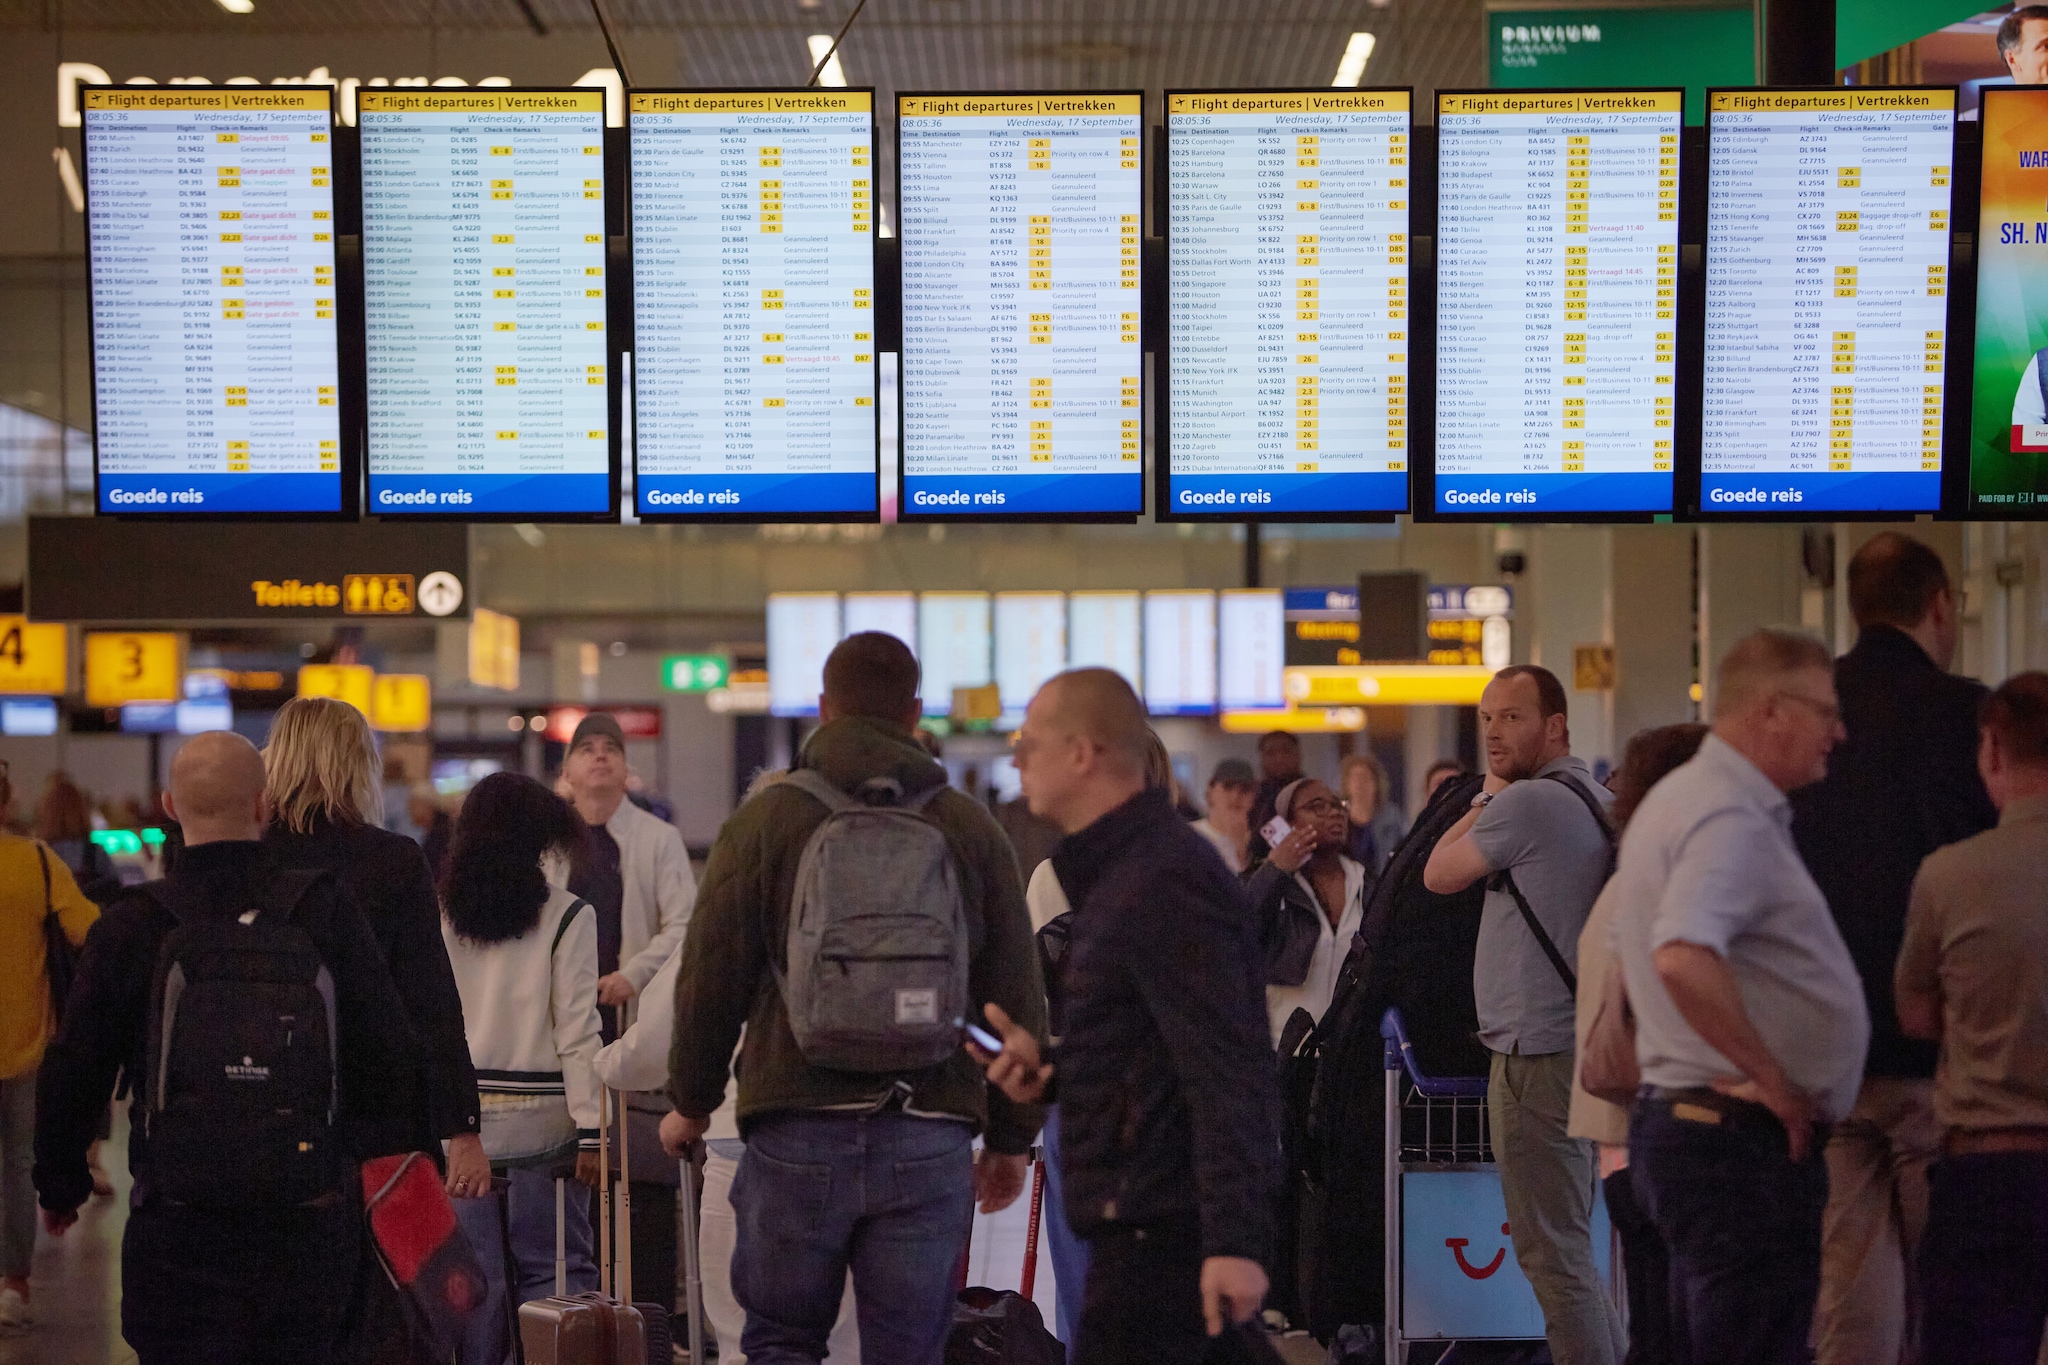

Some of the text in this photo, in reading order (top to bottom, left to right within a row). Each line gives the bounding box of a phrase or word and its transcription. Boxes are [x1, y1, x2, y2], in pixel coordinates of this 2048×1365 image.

[108, 94, 304, 108] Flight departures Vertrekken
[383, 96, 577, 110] Flight departures Vertrekken
[653, 97, 846, 112] Flight departures Vertrekken
[923, 100, 1116, 115] Flight departures Vertrekken
[1191, 97, 1384, 112] Flight departures Vertrekken
[1462, 97, 1656, 112] Flight departures Vertrekken
[1734, 95, 1929, 110] Flight departures Vertrekken
[88, 113, 128, 121] 08:05:36
[195, 113, 252, 123] Wednesday,
[271, 113, 323, 122] September
[363, 115, 403, 123] 08:05:36
[468, 115, 526, 124] Wednesday,
[544, 115, 596, 124] September
[633, 115, 864, 125] 08:05:36 Wednesday, 17 September
[902, 117, 1134, 128] 08:05:36 Wednesday, 17 September
[1171, 117, 1211, 125] 08:05:36
[1276, 115, 1332, 125] Wednesday,
[1351, 114, 1403, 124] September
[1441, 114, 1674, 125] 08:05:36 Wednesday, 17 September
[1713, 112, 1947, 123] 08:05:36 Wednesday, 17 September
[989, 130, 1008, 138] Flight
[1191, 138, 1235, 146] Copenhagen
[1659, 180, 1673, 188] D28
[2000, 222, 2029, 244] SH.
[923, 239, 939, 247] Riga
[1928, 266, 1942, 274] D47
[109, 488, 204, 504] Goede reis
[379, 489, 473, 504] Goede reis
[647, 489, 740, 504] Goede reis
[914, 489, 1006, 505] Goede reis
[1180, 489, 1271, 504] Goede reis
[1445, 489, 1536, 504] Goede reis
[1710, 488, 1803, 502] Goede reis
[1979, 495, 1993, 503] PAID
[1994, 495, 2006, 503] FOR
[2007, 495, 2015, 503] BY
[251, 579, 340, 607] Toilets
[119, 638, 143, 682] 3
